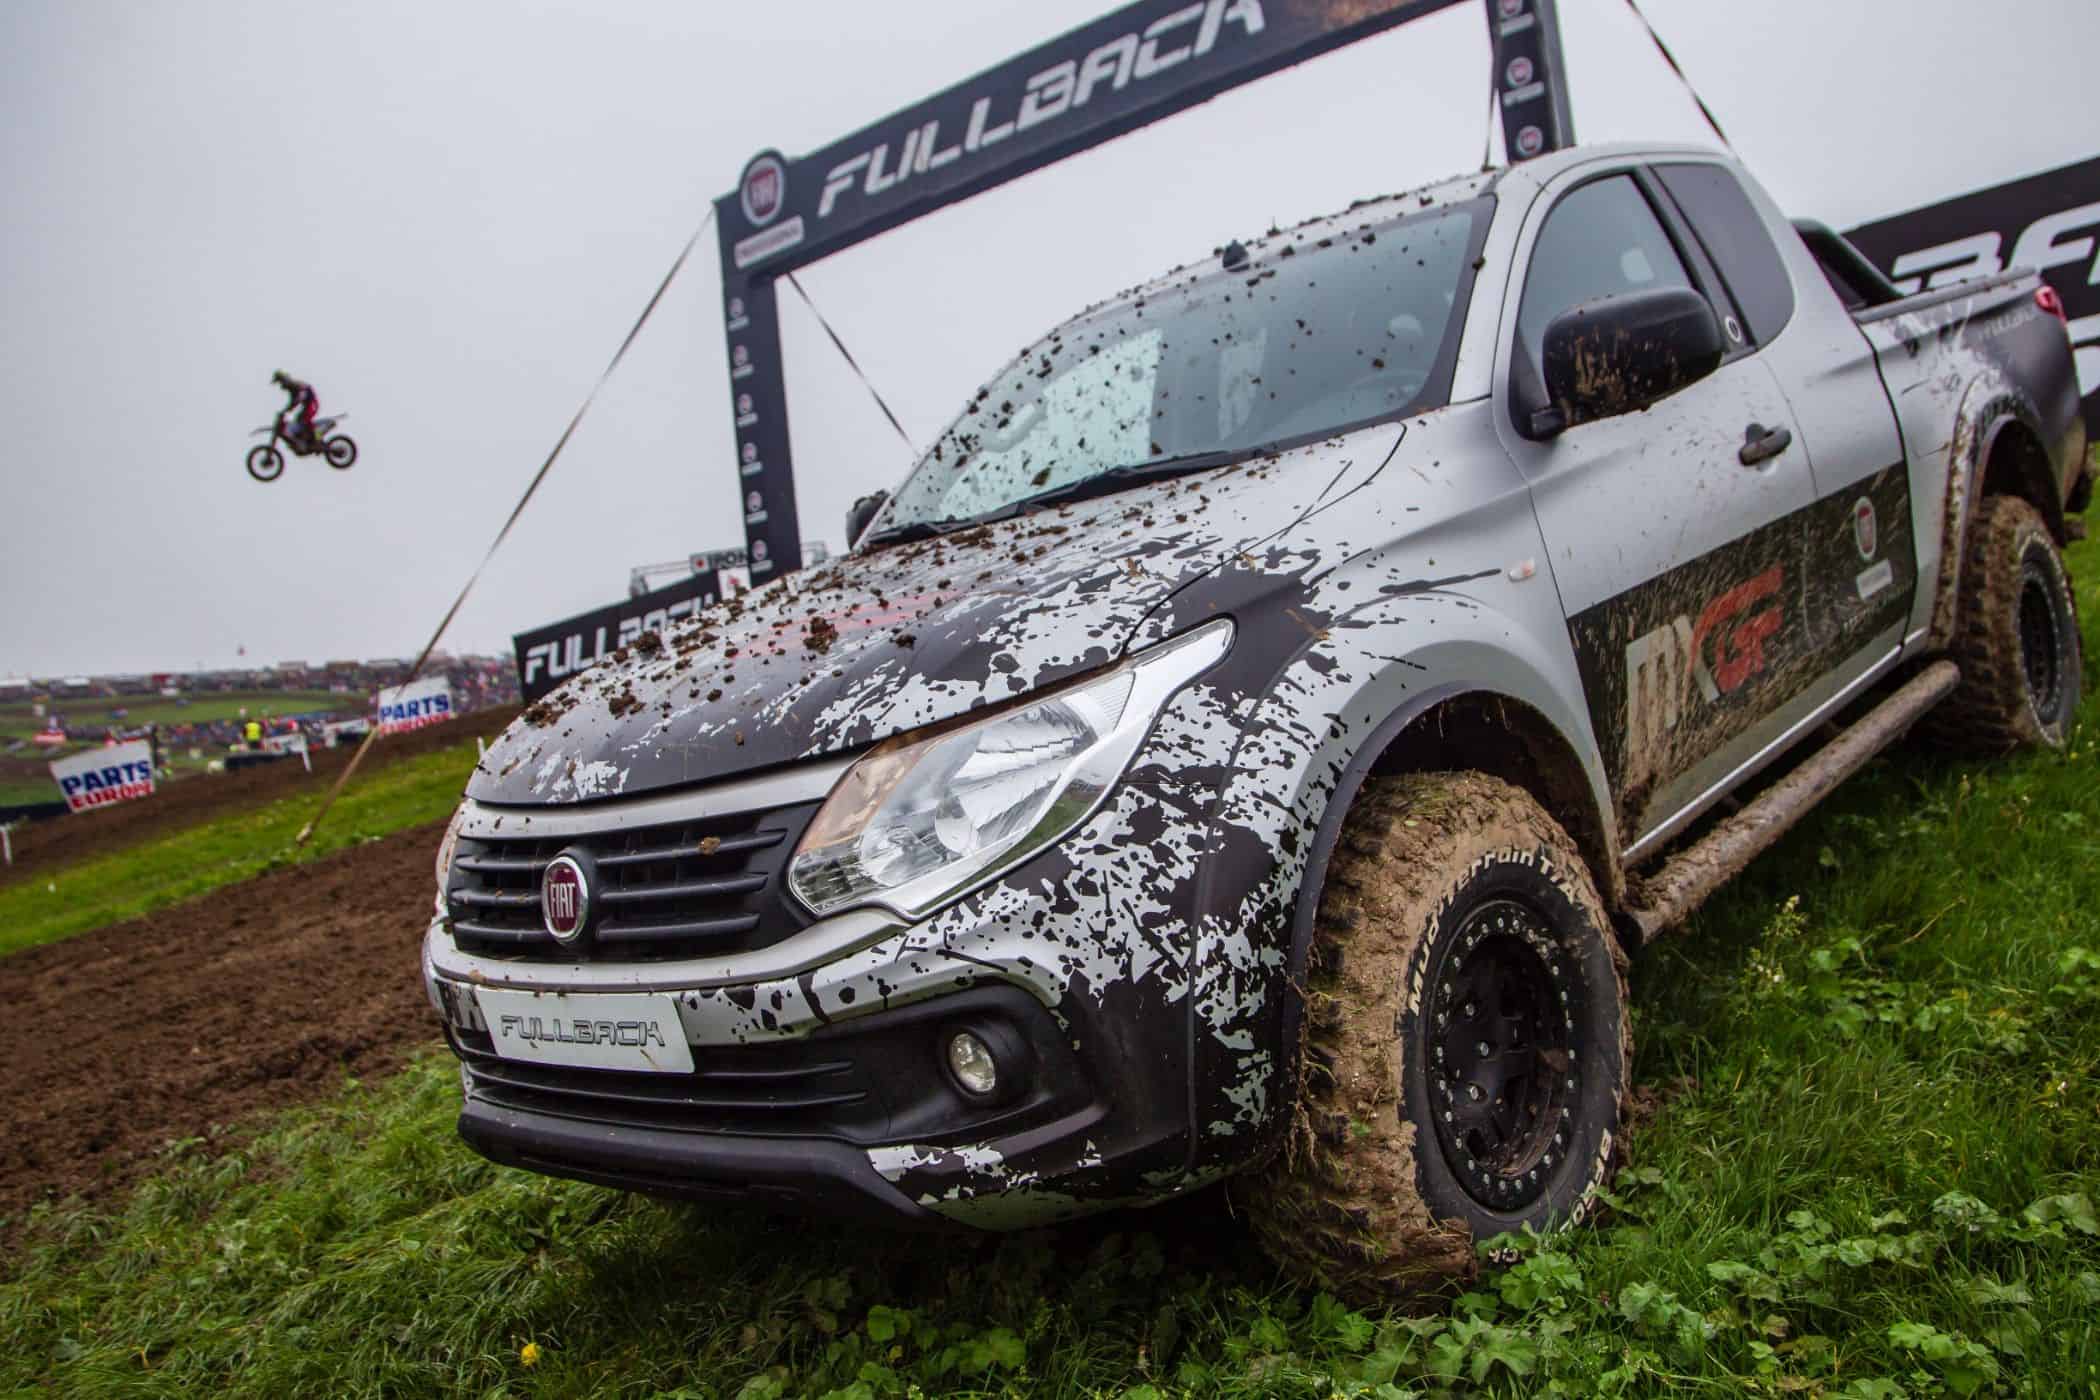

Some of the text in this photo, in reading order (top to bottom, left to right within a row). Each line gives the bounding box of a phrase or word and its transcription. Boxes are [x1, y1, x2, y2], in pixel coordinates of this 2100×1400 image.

[817, 0, 1265, 219] FULLBACK
[380, 693, 449, 722] PARTS
[61, 761, 151, 796] PARTS
[550, 882, 576, 919] FIAT
[500, 1015, 666, 1048] FULLBACK
